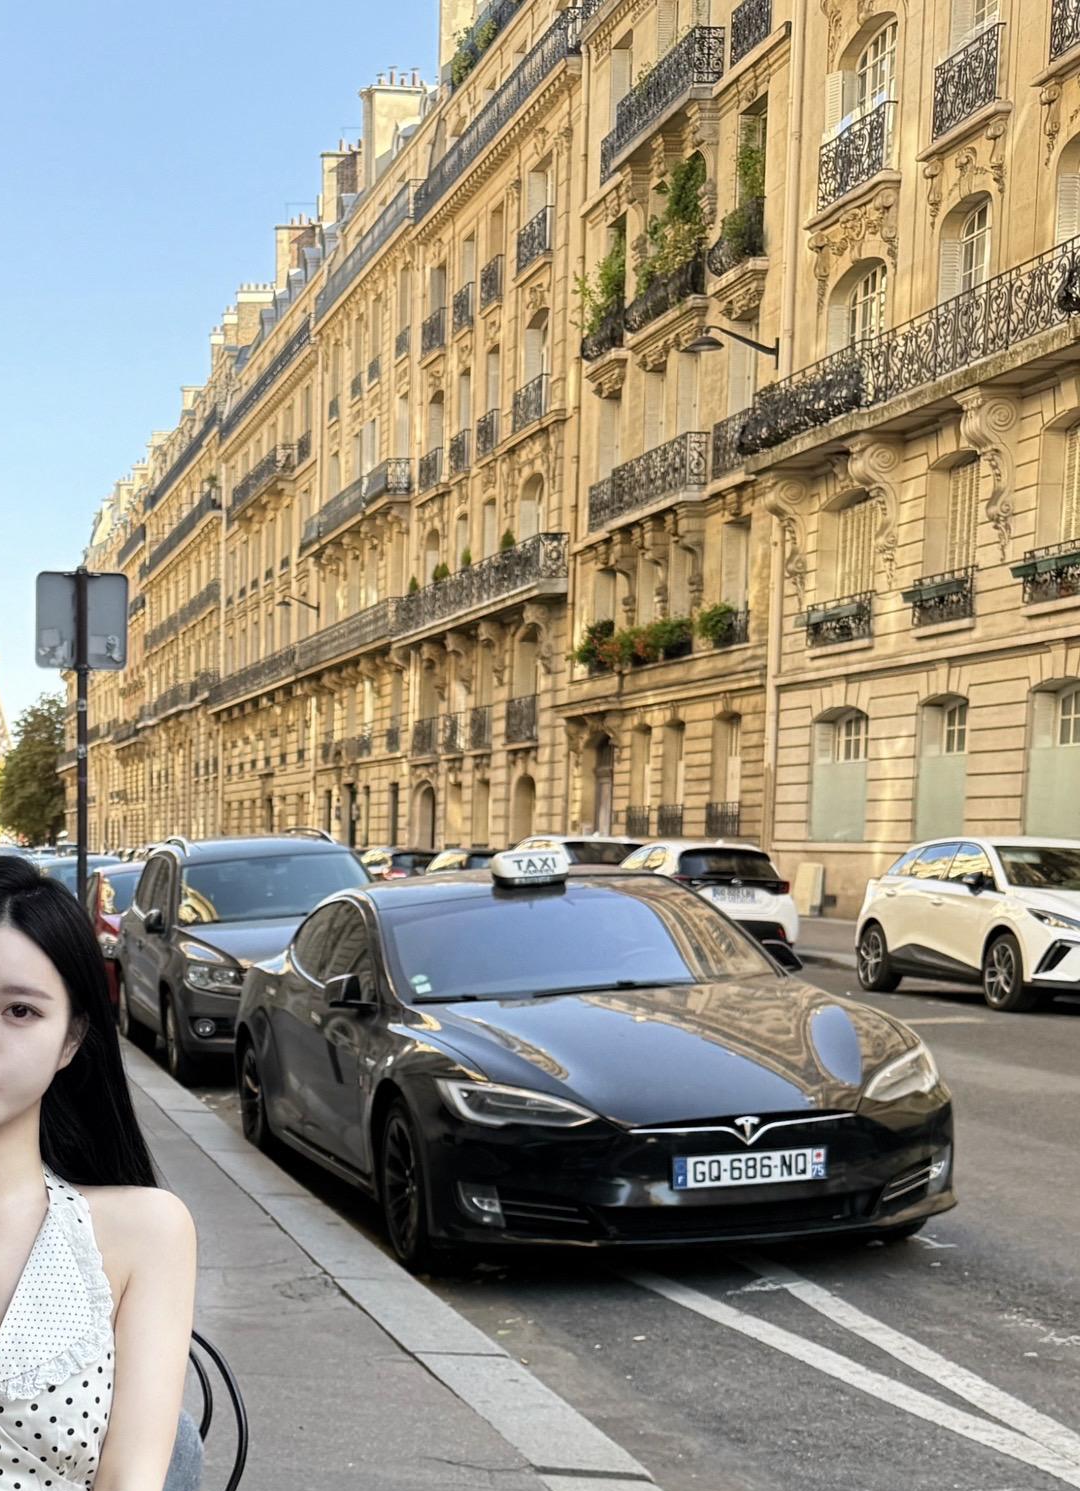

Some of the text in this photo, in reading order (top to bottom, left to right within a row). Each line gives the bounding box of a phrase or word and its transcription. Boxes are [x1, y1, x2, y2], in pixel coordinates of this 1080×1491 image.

[512, 857, 557, 871] TAXI
[693, 1153, 807, 1183] GQ-686-NQ
[812, 1165, 825, 1176] 75
